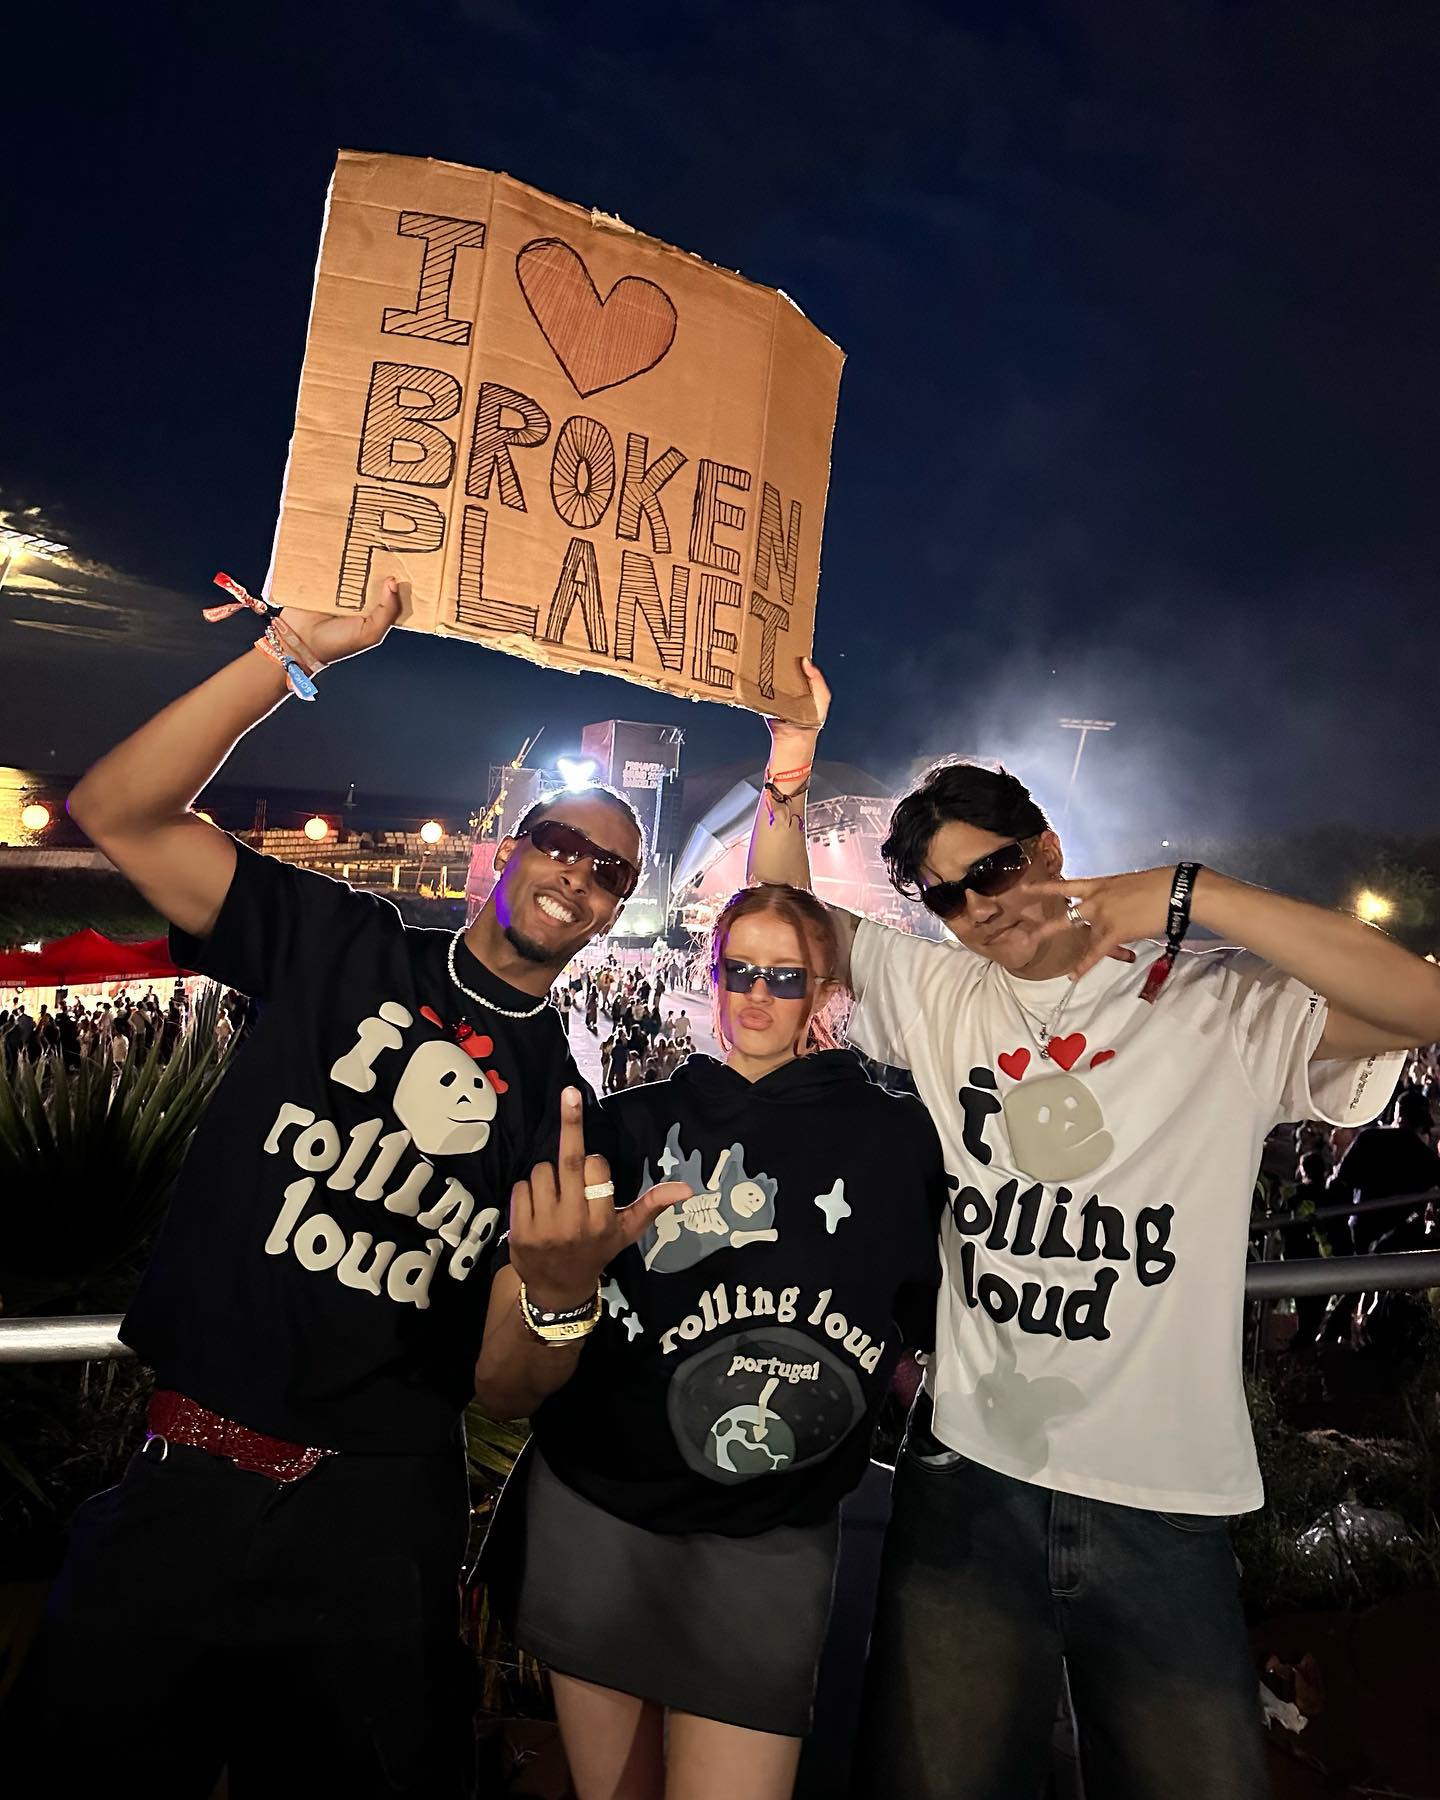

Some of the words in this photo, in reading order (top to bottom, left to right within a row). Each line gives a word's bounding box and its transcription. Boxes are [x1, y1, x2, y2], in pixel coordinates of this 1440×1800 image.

[381, 210, 487, 346] I
[356, 361, 801, 606] BROKEN
[335, 483, 790, 701] PLANET
[330, 1001, 414, 1093] i
[958, 1066, 1002, 1166] i
[263, 1102, 500, 1281] rolling
[264, 1176, 444, 1310] loud
[658, 1282, 800, 1355] rolling
[807, 1288, 886, 1375] loud
[960, 1241, 1119, 1341] loud
[726, 1355, 820, 1384] portugal
